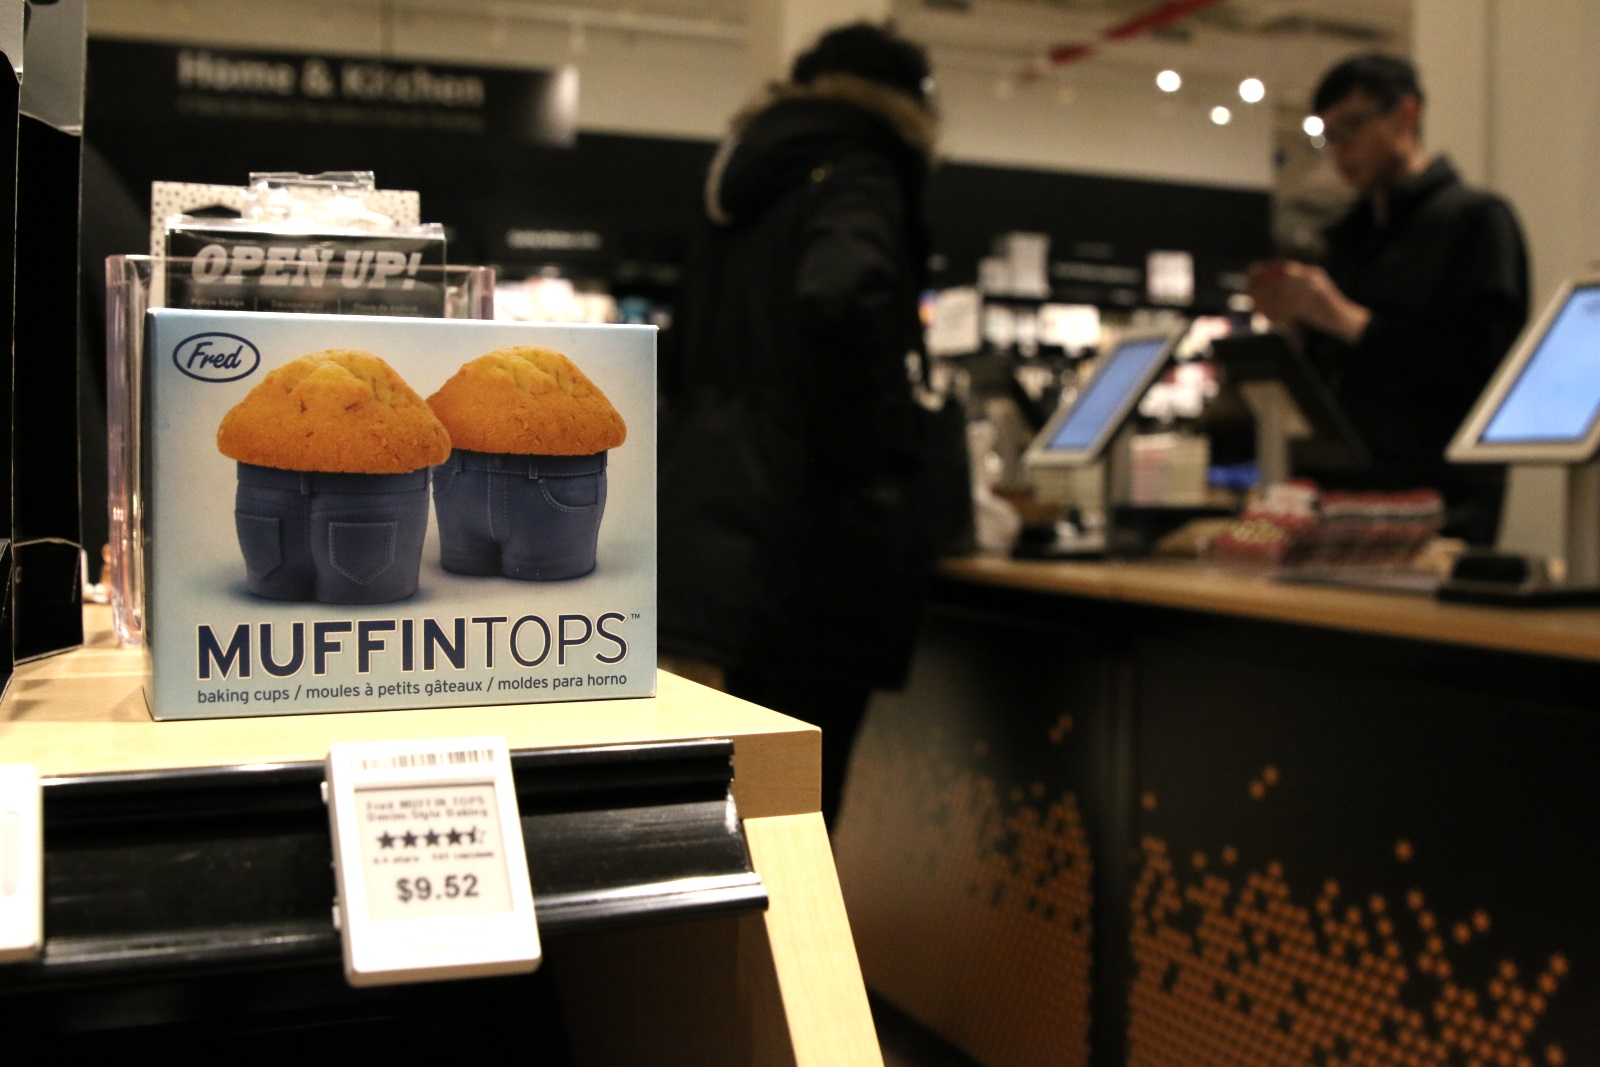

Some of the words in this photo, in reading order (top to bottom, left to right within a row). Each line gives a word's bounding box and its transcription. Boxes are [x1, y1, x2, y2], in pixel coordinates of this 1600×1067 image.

[176, 50, 294, 95] Home
[299, 57, 335, 98] &
[341, 64, 485, 107] Kitchen
[191, 243, 336, 288] OPEN
[342, 249, 422, 290] UP!
[186, 341, 243, 370] Fred
[198, 686, 249, 704] baking
[254, 687, 289, 702] cups
[294, 685, 302, 700] /
[306, 683, 360, 698] moules
[365, 682, 374, 696] à
[378, 680, 420, 697] petits
[425, 678, 482, 695] gâteaux
[486, 676, 494, 691] /
[498, 675, 548, 690] moldes
[552, 676, 584, 690] para
[587, 672, 627, 686] horno
[396, 873, 479, 903] $9.52
